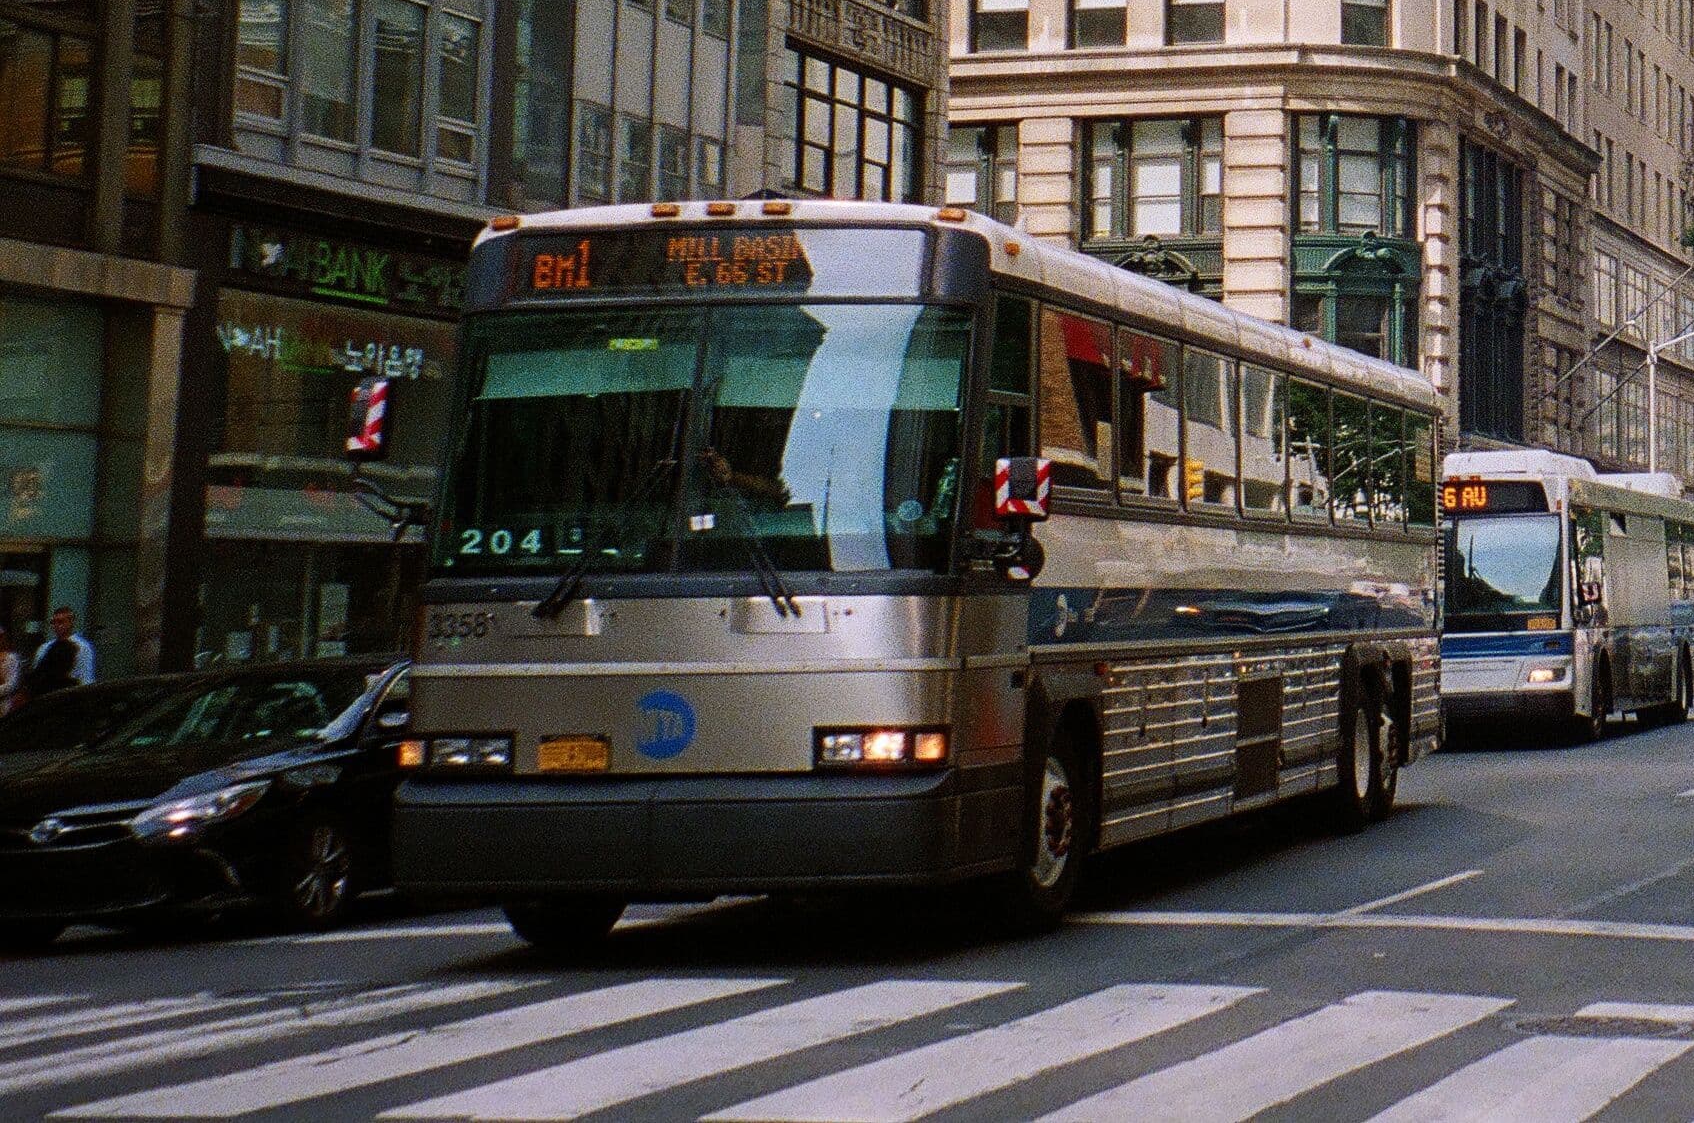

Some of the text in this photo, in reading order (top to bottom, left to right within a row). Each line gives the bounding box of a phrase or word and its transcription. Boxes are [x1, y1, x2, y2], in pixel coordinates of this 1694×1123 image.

[667, 235, 723, 263] MILL
[316, 239, 389, 295] BANK
[533, 240, 592, 289] BM1
[756, 260, 789, 284] ST
[459, 529, 543, 555] 204
